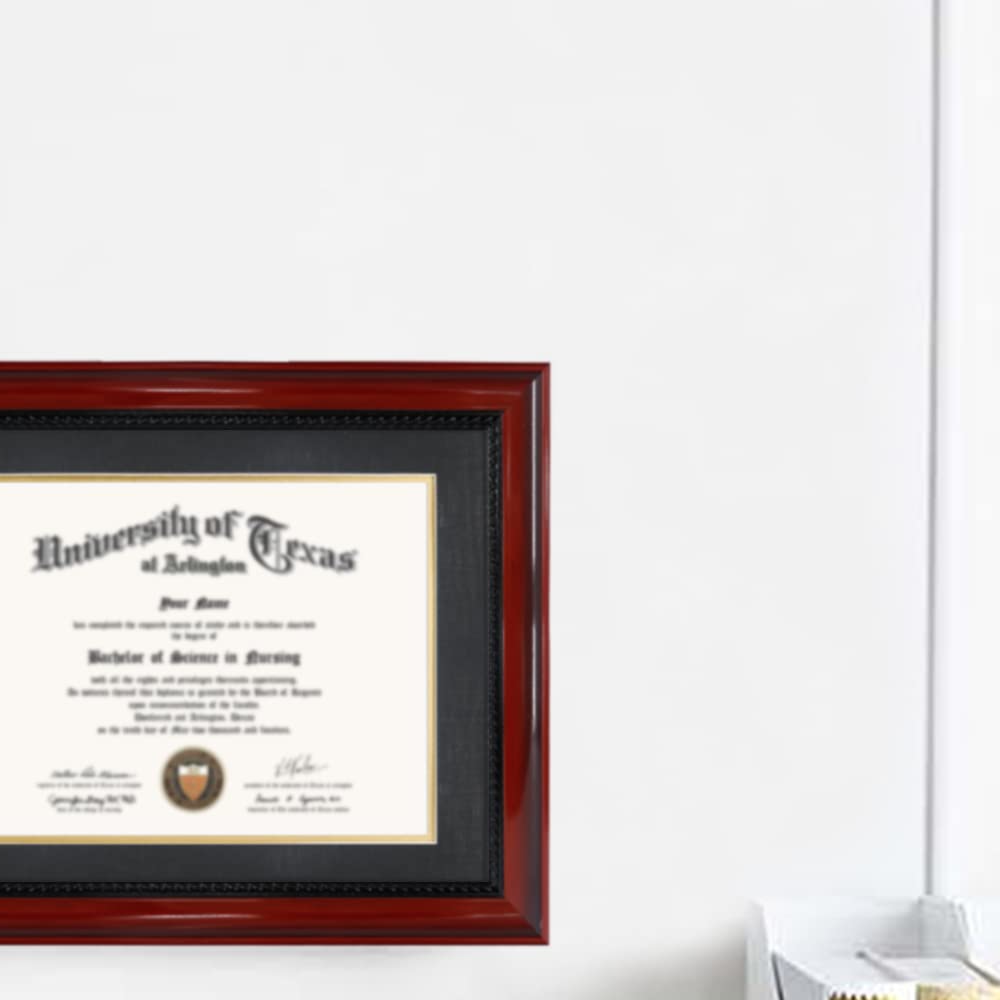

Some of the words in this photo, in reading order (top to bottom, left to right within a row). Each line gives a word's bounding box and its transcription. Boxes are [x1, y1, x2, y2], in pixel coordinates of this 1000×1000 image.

[32, 504, 201, 572] University
[204, 509, 243, 541] of
[247, 514, 358, 575] Texas
[161, 552, 248, 577] Arlington
[158, 595, 189, 612] Your
[193, 595, 230, 612] Name
[87, 648, 145, 666] Bachelor
[149, 648, 164, 665] of
[169, 649, 219, 666] Science
[223, 650, 238, 665] in
[244, 648, 302, 668] Nursing
